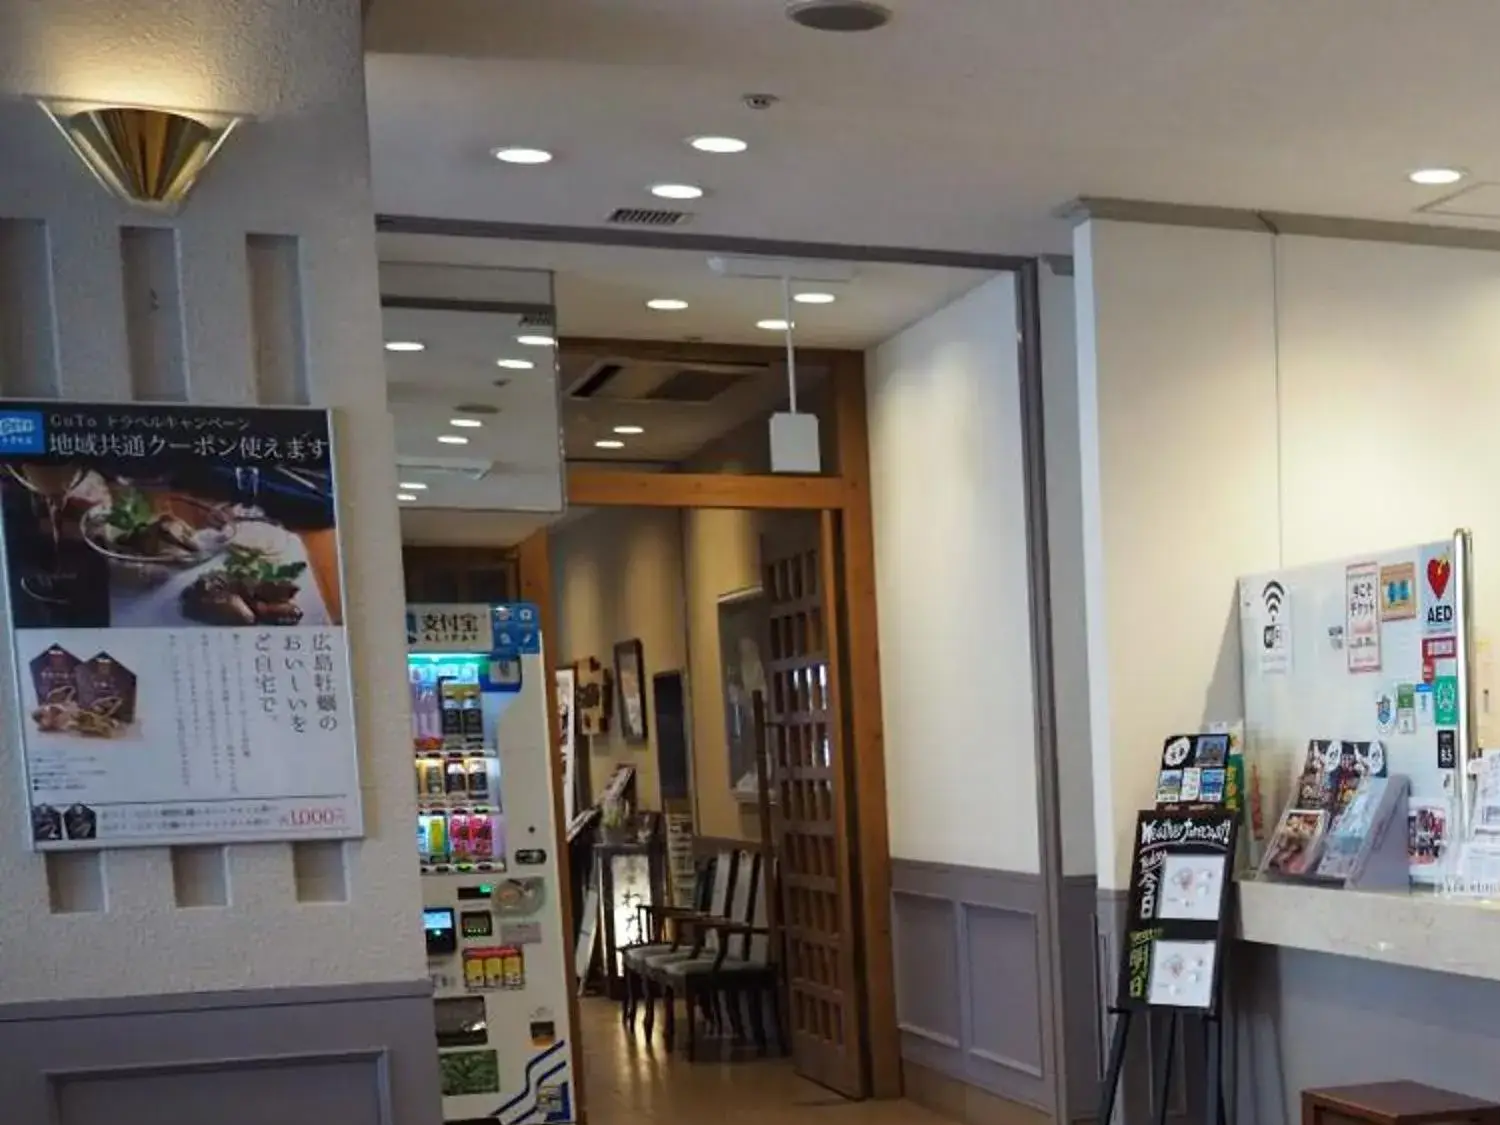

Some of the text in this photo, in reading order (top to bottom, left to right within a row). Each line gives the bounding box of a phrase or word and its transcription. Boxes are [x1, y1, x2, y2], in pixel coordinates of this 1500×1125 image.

[49, 432, 330, 461] 地域共通クーポン使えます
[421, 611, 479, 633] 支付宝
[1427, 605, 1453, 622] AED
